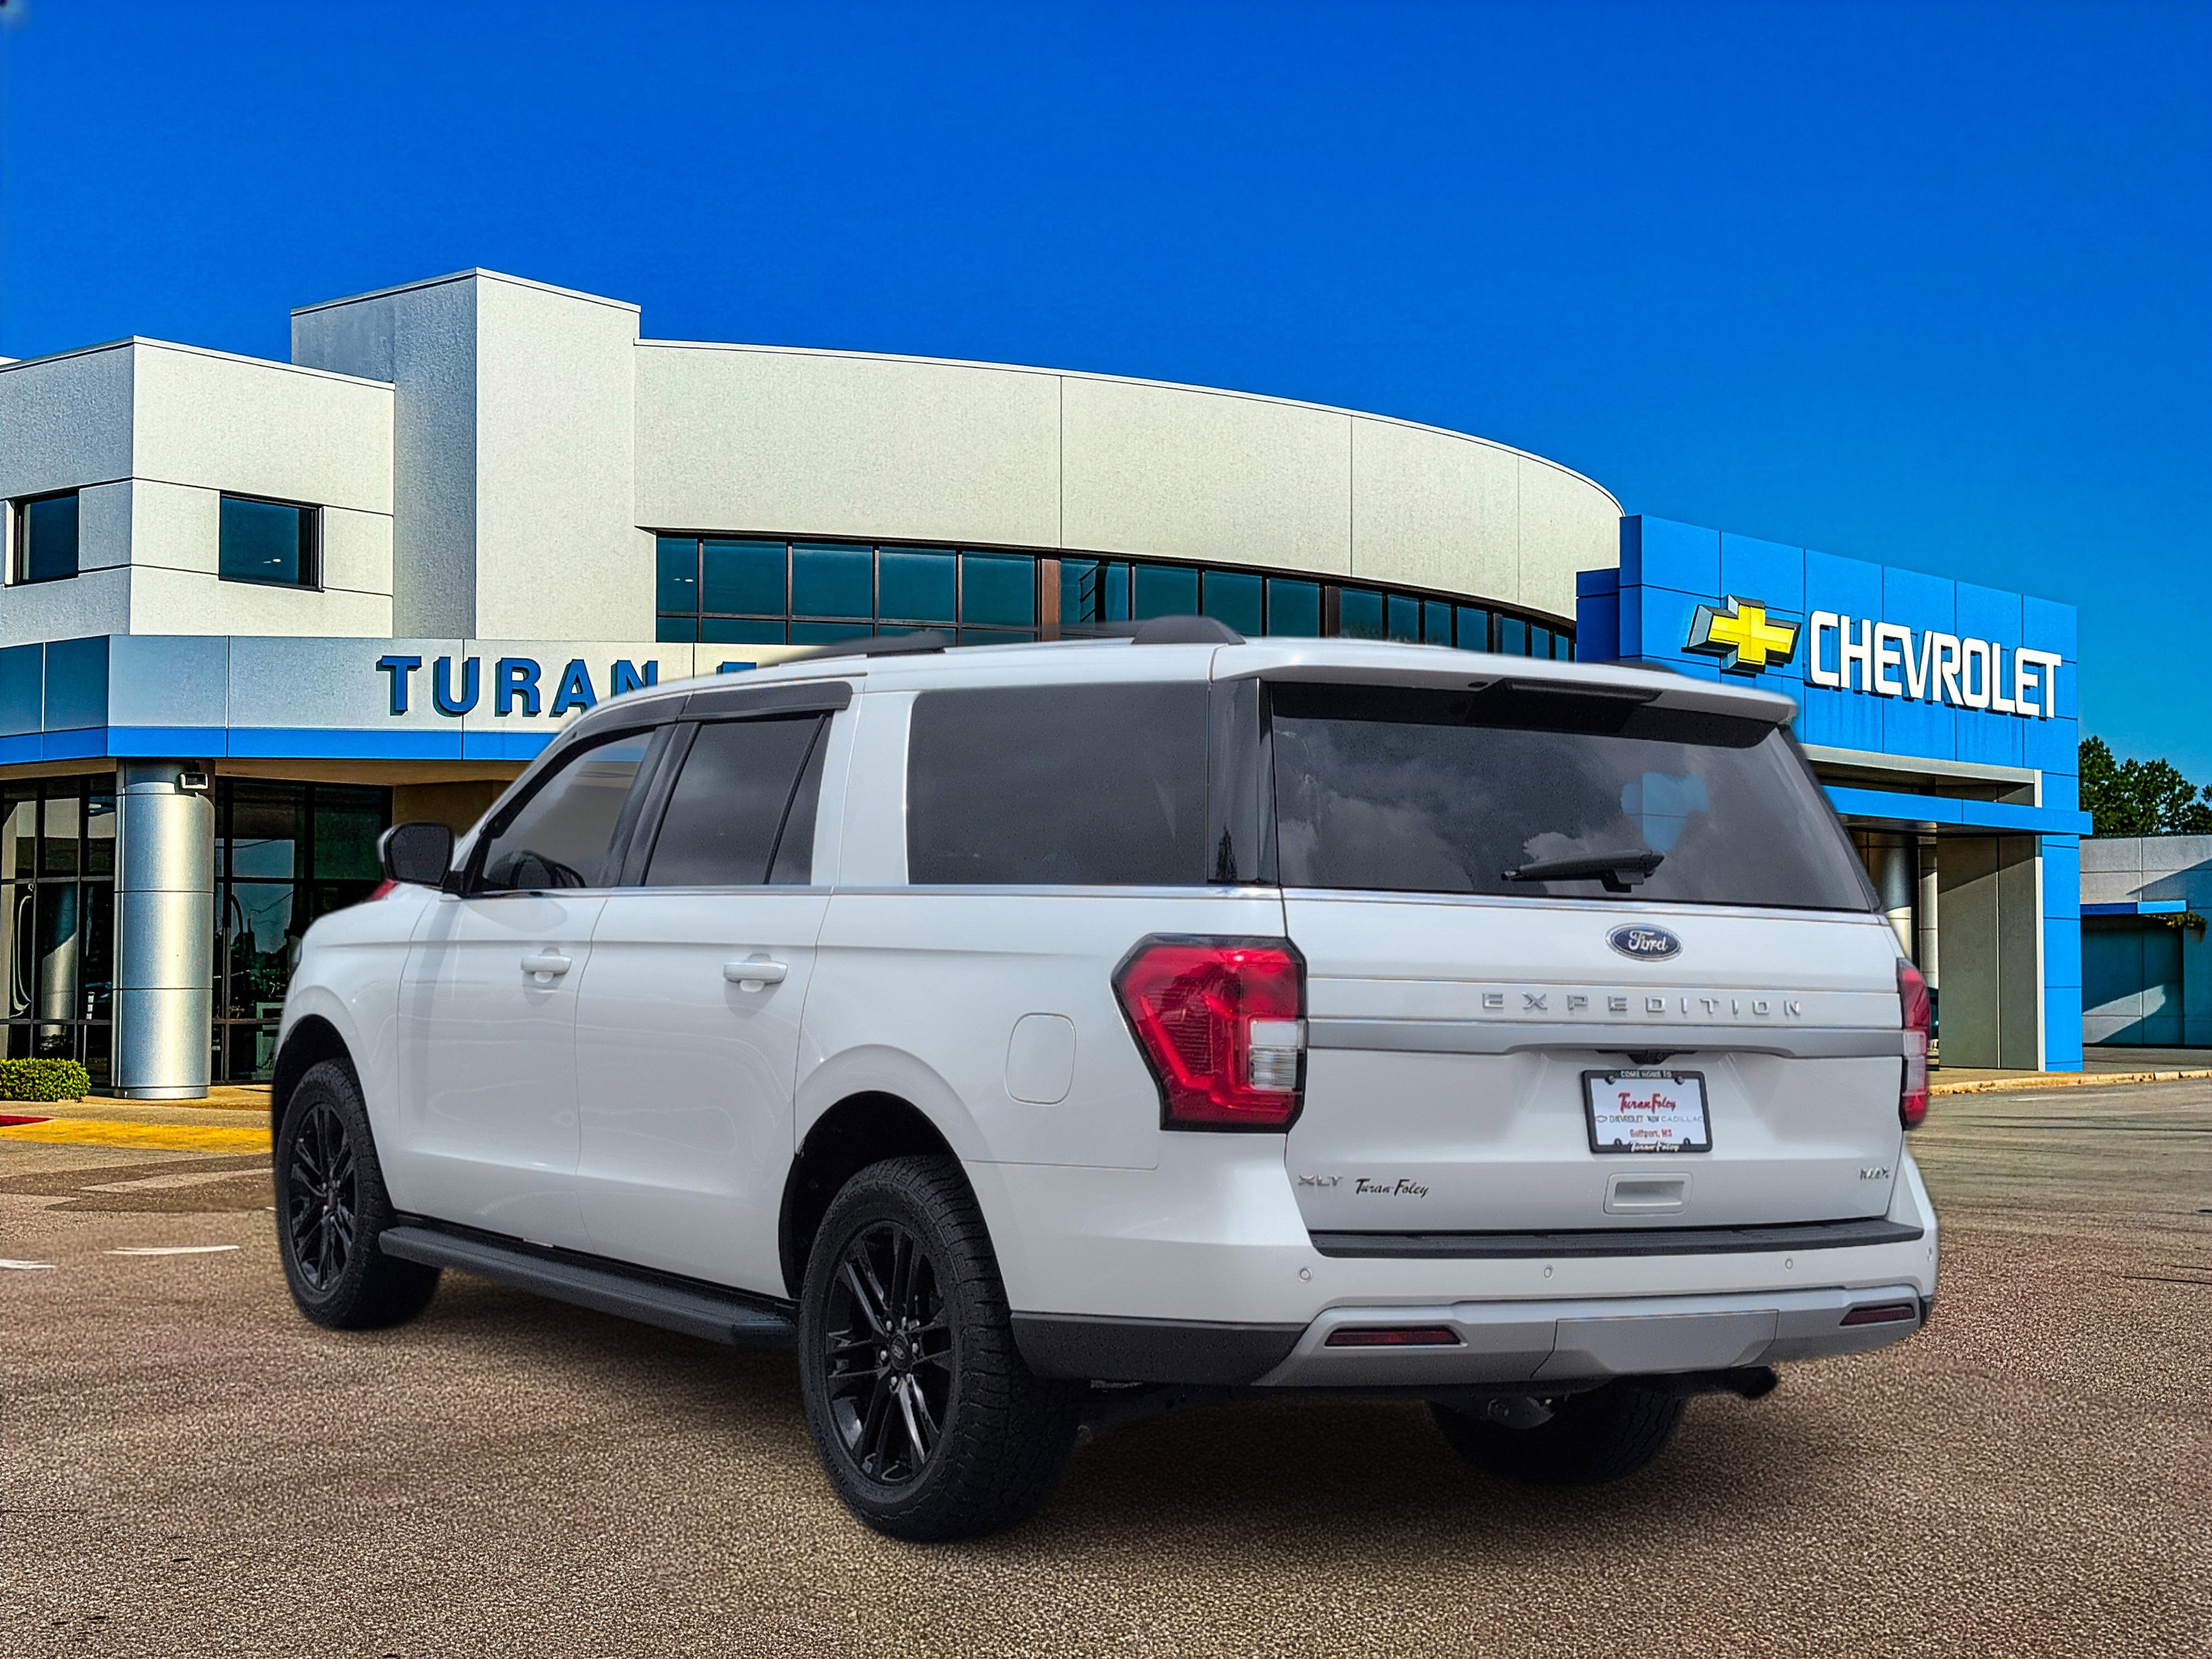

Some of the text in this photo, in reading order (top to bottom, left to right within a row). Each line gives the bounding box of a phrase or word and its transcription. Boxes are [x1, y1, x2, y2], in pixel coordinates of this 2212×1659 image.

[1808, 609, 2062, 719] CHEVROLET
[376, 655, 658, 717] TURAN
[1482, 992, 1801, 1016] EXPEDITION
[1298, 1174, 1343, 1186] XLT
[1392, 1178, 1430, 1199] Foley
